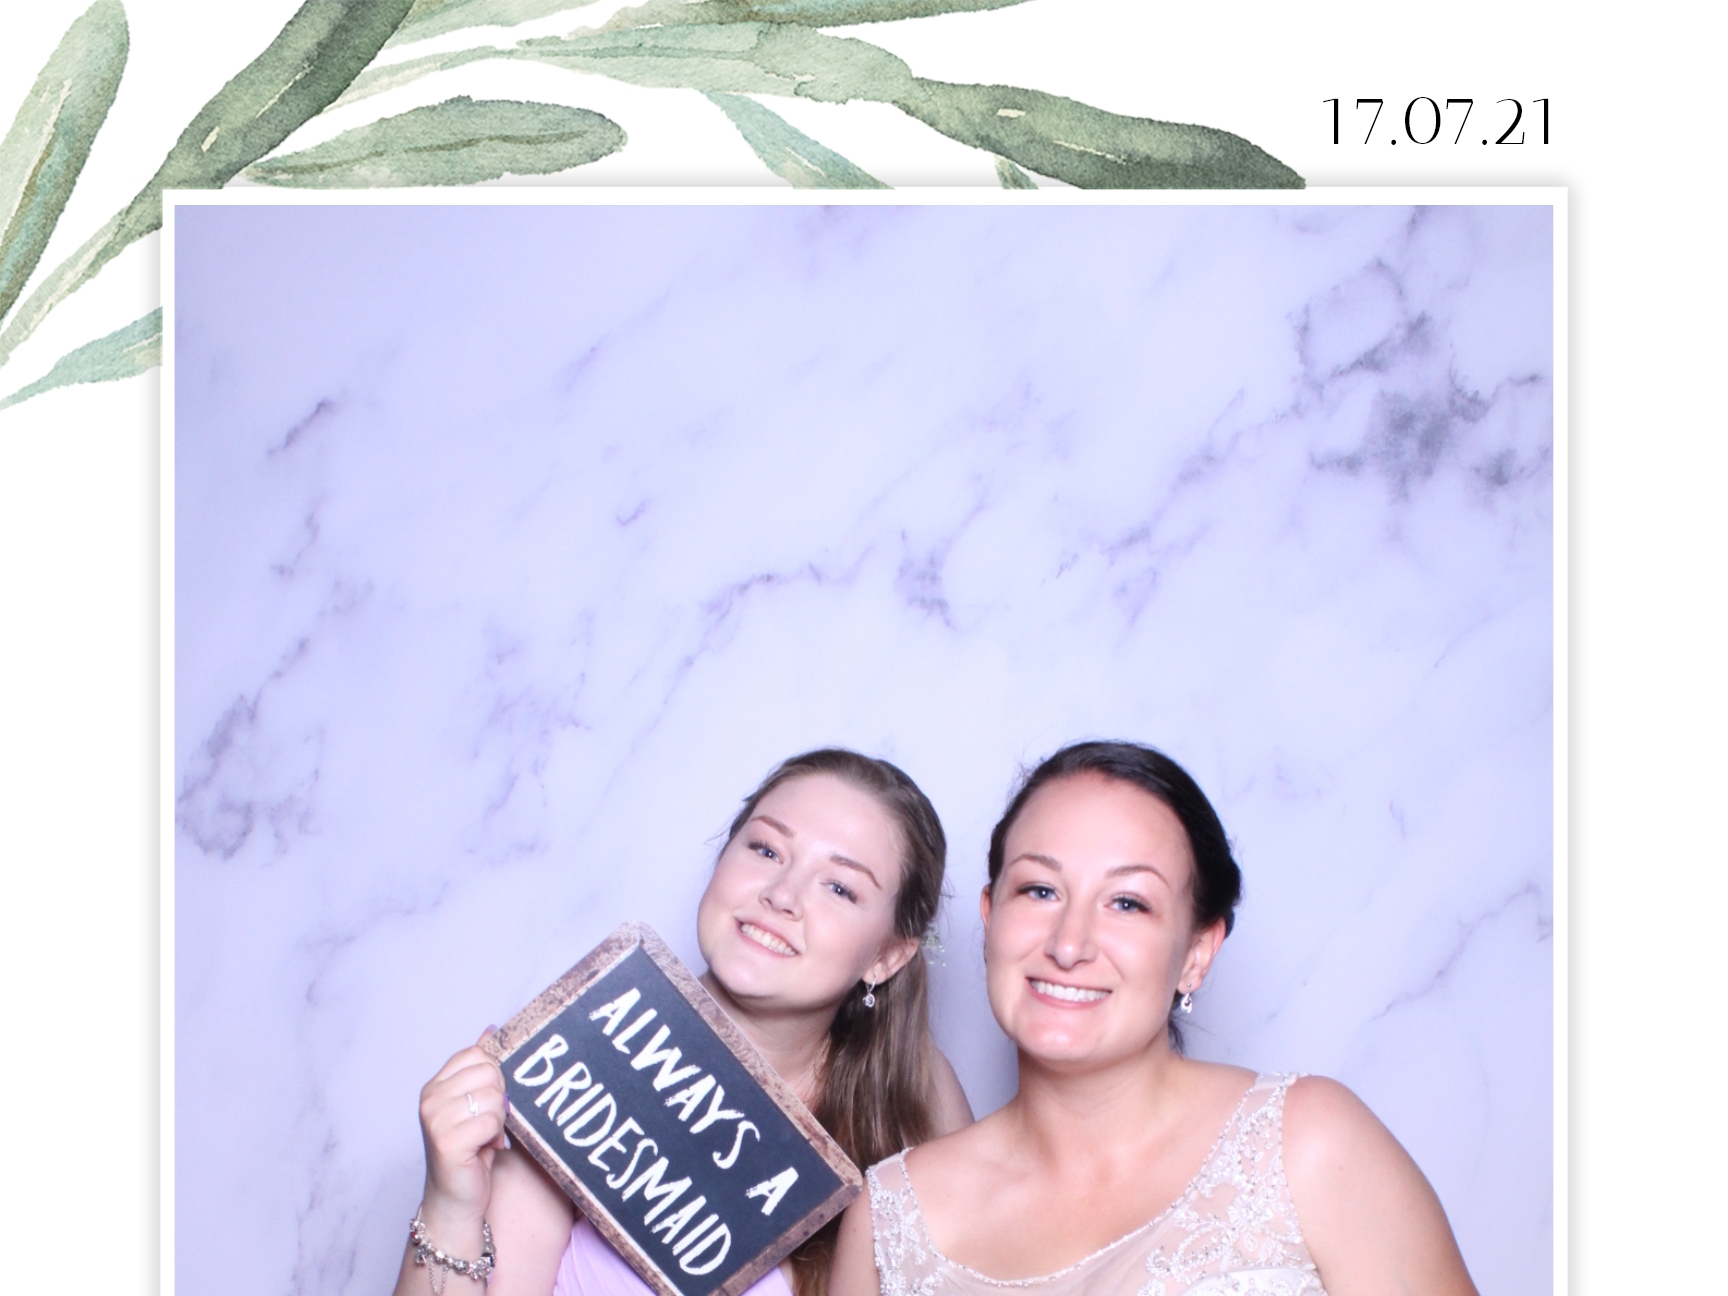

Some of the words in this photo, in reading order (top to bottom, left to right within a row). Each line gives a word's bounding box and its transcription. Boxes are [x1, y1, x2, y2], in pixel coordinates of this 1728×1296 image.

[513, 1034, 732, 1275] BRIDESMAID
[589, 988, 761, 1169] ALWAYS
[745, 1167, 799, 1215] A
